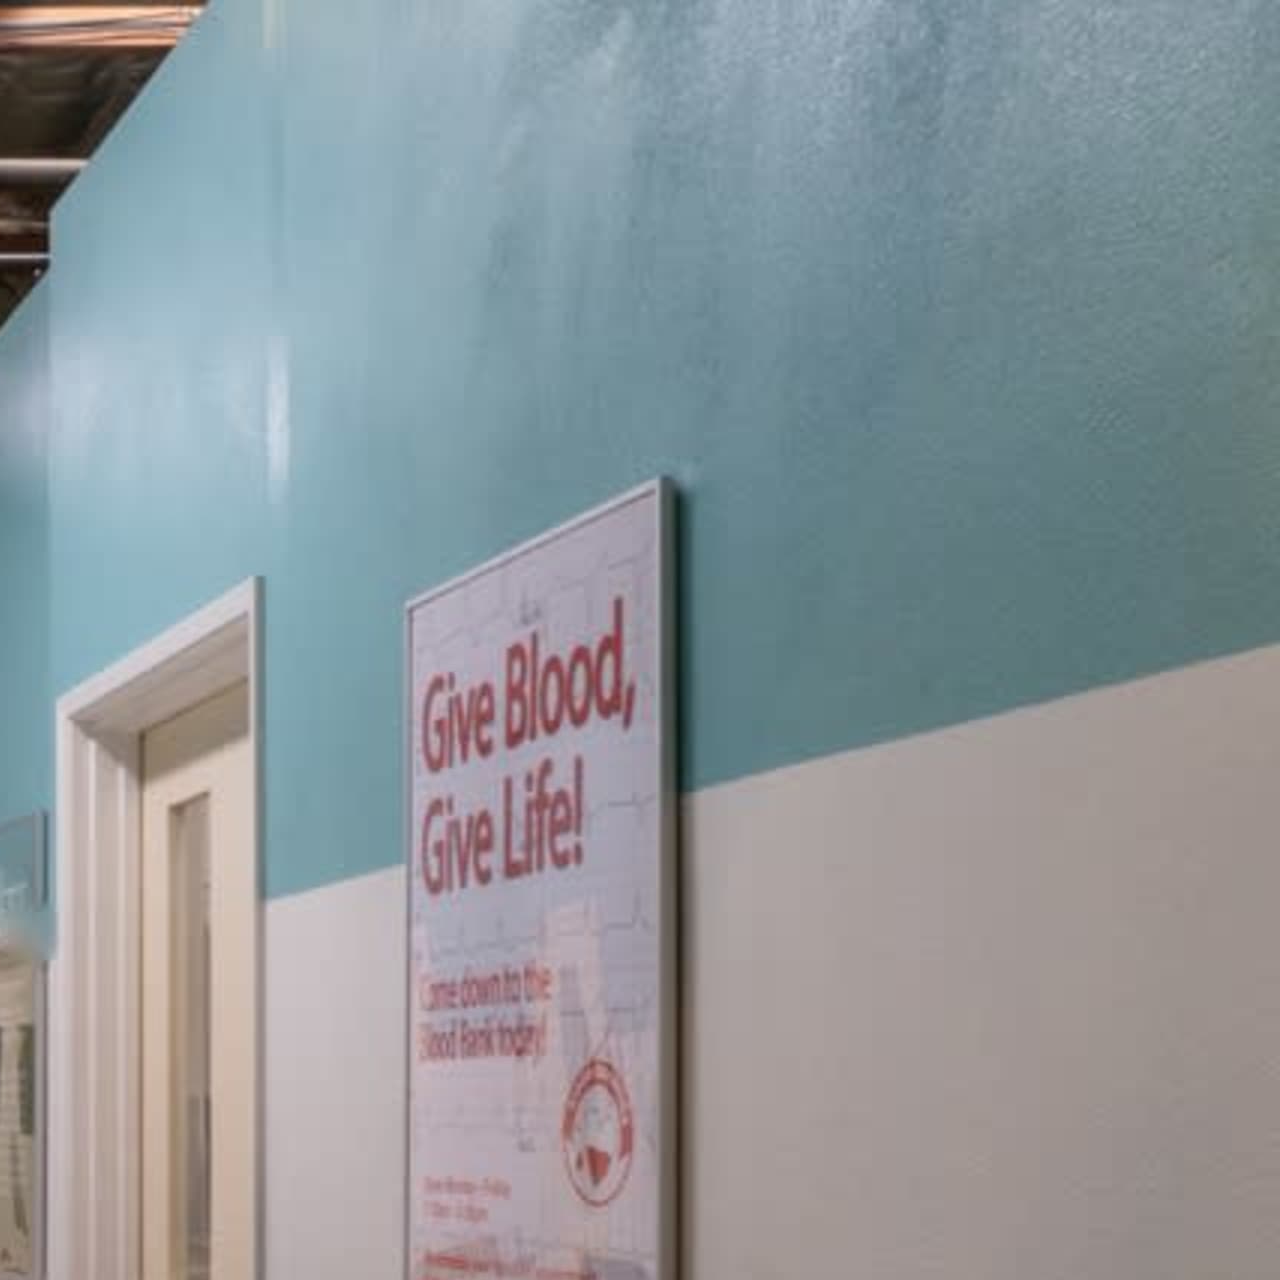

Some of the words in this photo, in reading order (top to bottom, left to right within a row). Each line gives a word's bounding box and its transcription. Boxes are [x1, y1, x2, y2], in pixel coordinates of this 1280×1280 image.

[421, 672, 495, 773] Give
[505, 596, 635, 749] Blood,
[421, 797, 493, 896] Give
[503, 756, 585, 880] Life!
[461, 965, 503, 1008] down
[523, 960, 552, 1001] the
[461, 1018, 495, 1059] Bank
